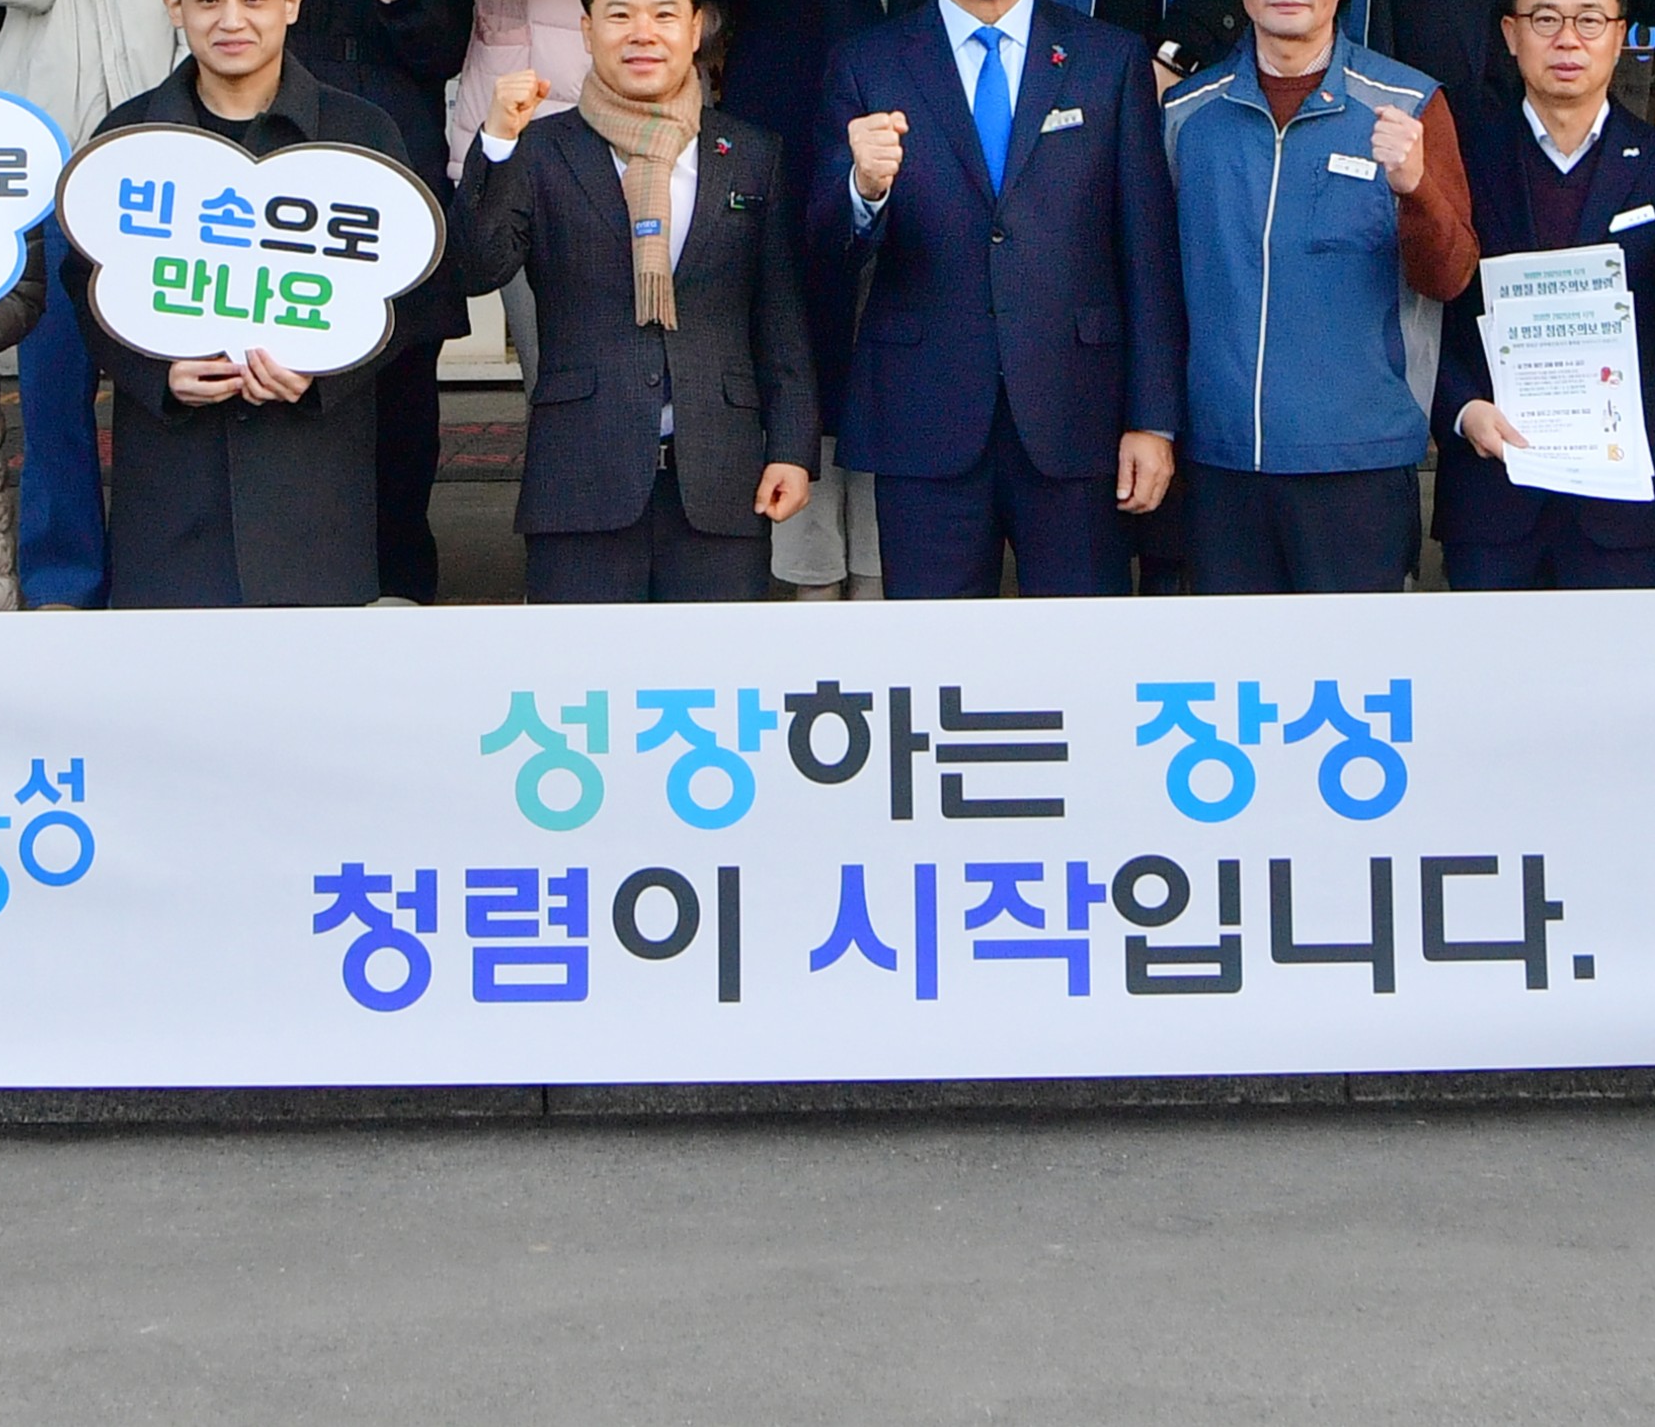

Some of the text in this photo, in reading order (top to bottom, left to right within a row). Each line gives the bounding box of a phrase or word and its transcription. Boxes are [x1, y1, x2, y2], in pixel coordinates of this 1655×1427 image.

[119, 178, 381, 264] 빈 손으로
[151, 256, 334, 331] 만나요
[481, 679, 1412, 831] 성장하는 장성
[313, 854, 1595, 1012] 청렴이 시작입니다.
